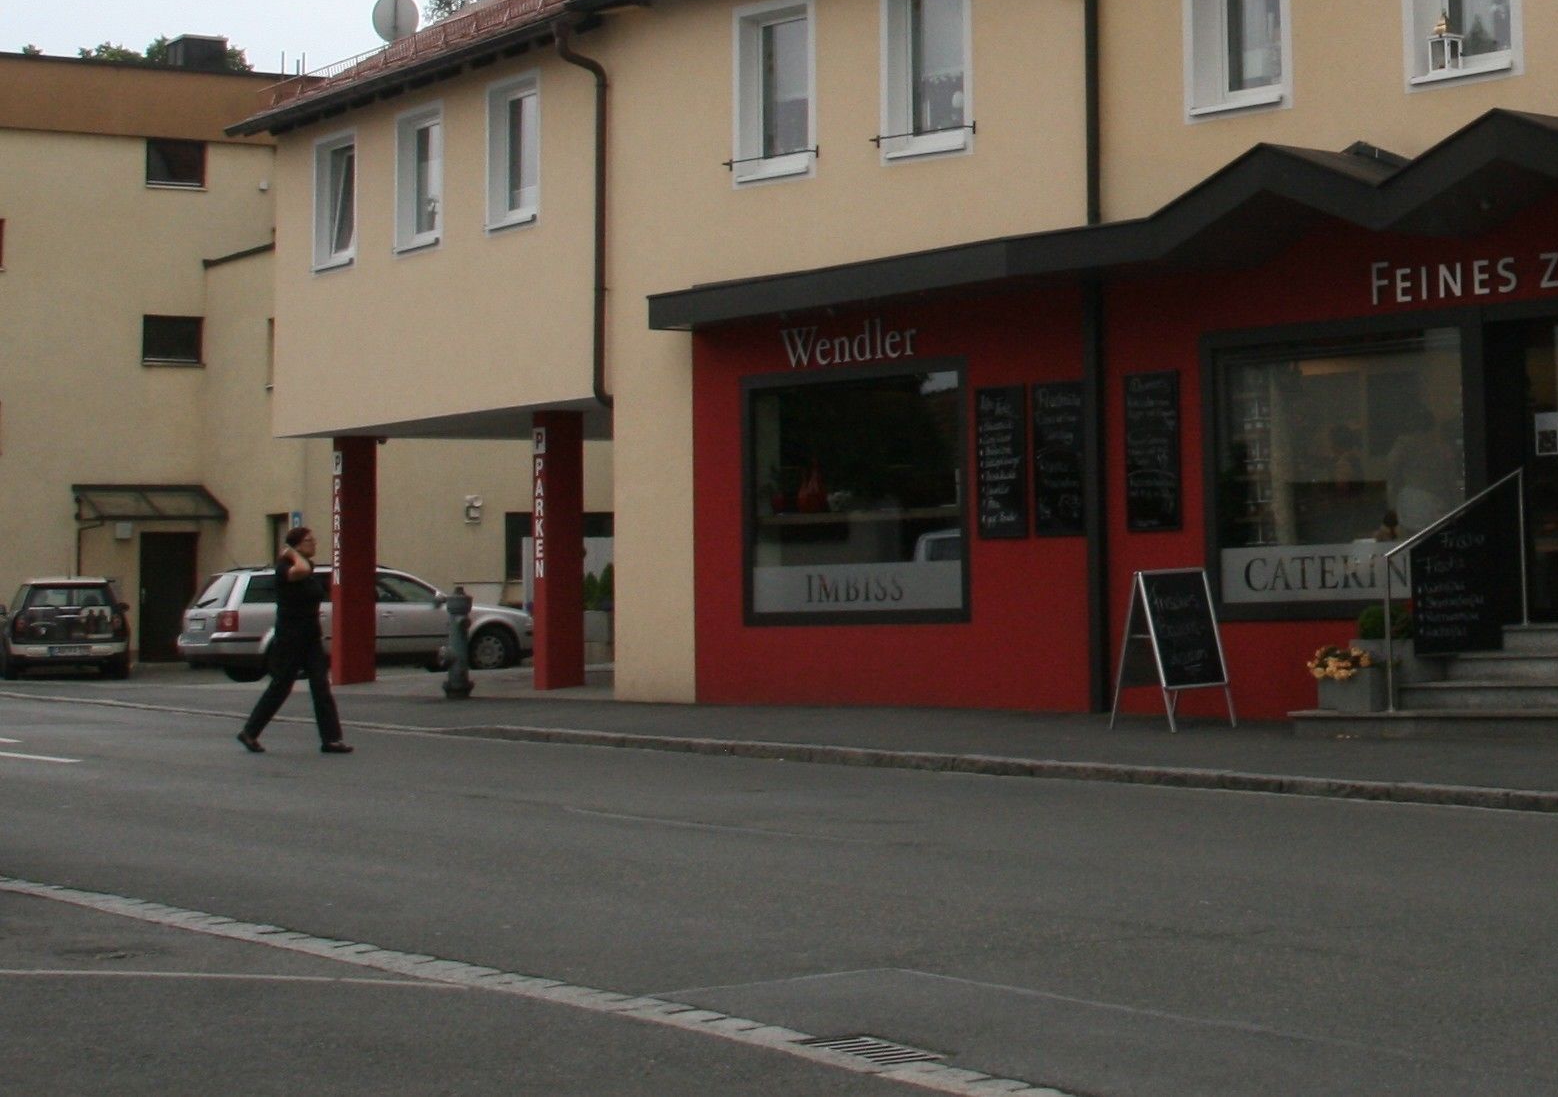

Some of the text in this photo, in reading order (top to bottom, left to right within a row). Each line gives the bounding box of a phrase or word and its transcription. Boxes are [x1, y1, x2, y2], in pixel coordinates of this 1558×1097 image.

[1369, 256, 1518, 306] FEINES
[779, 317, 918, 369] Wendler
[332, 477, 342, 585] PARKEN
[534, 457, 545, 579] PARKEN
[806, 572, 904, 603] IMBISS
[1244, 554, 1408, 593] CATERIN
